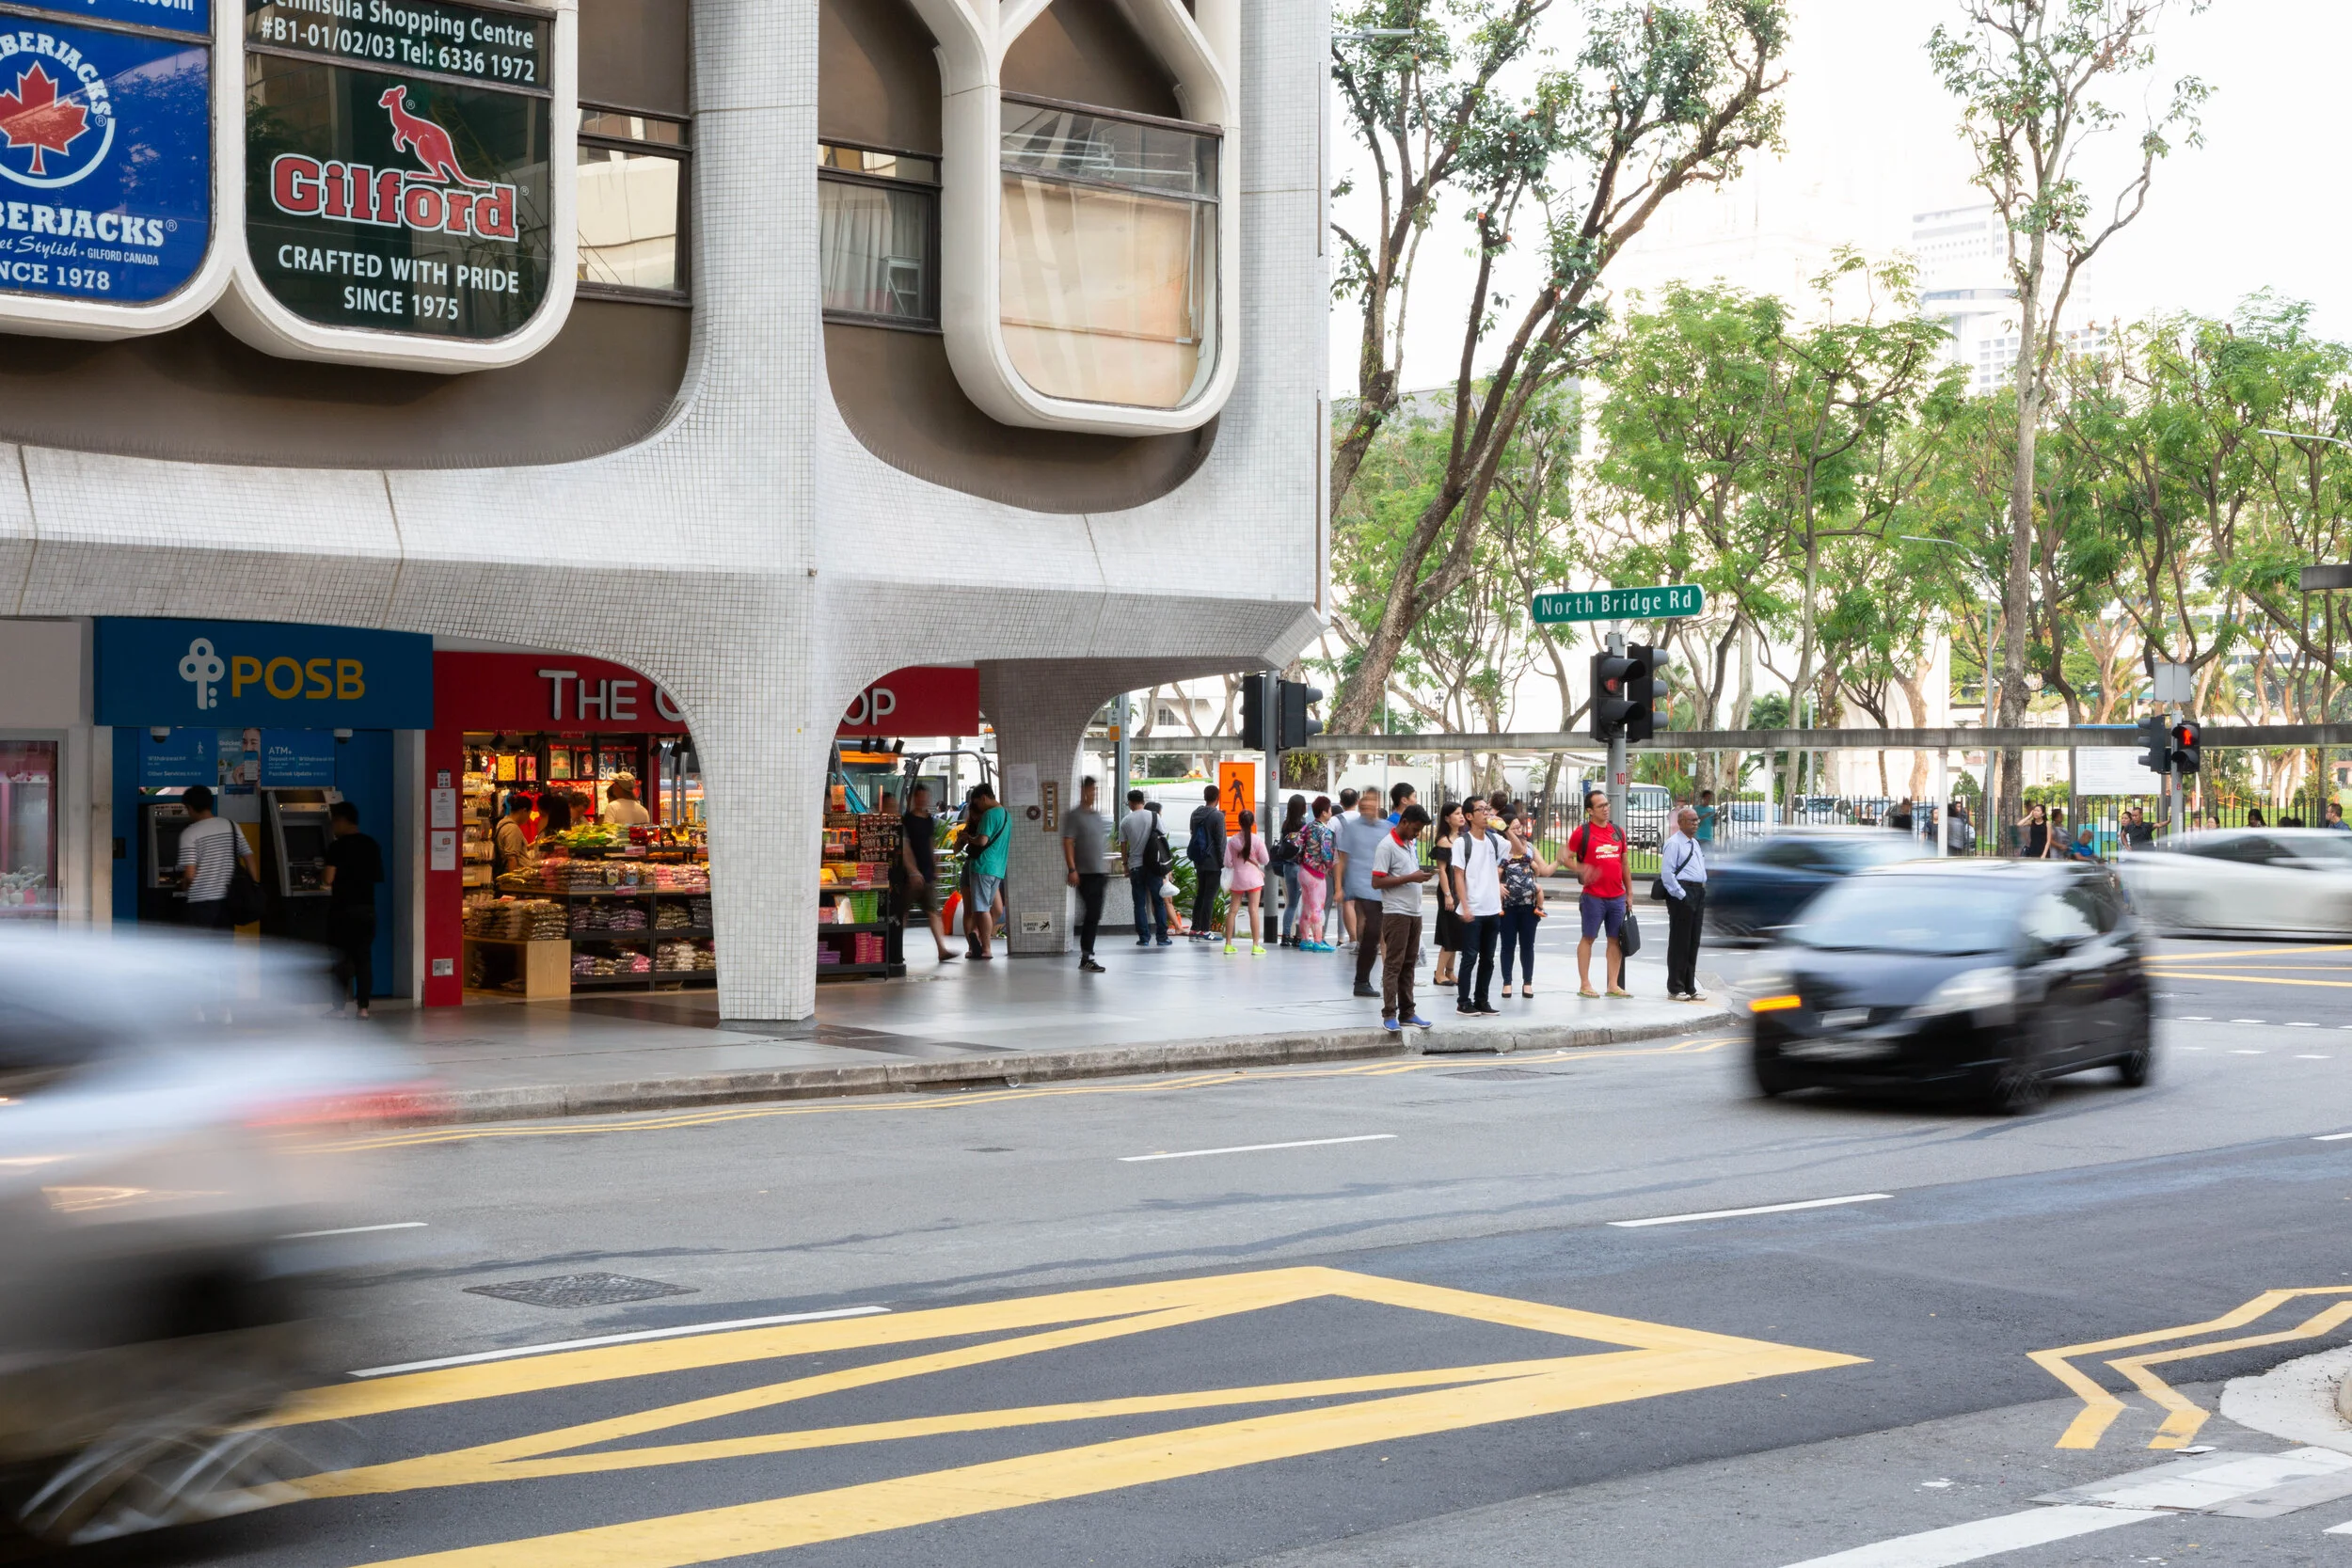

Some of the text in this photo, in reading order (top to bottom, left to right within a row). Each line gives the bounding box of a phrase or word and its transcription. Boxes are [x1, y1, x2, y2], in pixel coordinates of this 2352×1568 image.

[370, 0, 465, 43] Shopping
[470, 18, 534, 49] Centre
[262, 16, 534, 82] #B1-01/02/03 Tel: 6336 1972
[0, 31, 111, 115] BERJACKS
[271, 153, 518, 242] Gilford
[0, 200, 164, 247] ERJACKS
[14, 235, 77, 260] Stylish
[87, 247, 122, 262] GILFORD
[123, 251, 159, 265] CANADA
[278, 245, 519, 293] CRAFTED WITH PRIDE
[56, 266, 110, 290] 1978
[344, 286, 458, 320] SINCE 1975
[1541, 590, 1692, 615] North Bridge Rd
[231, 656, 365, 700] POSB
[538, 669, 637, 721] THE
[842, 688, 896, 726] OP
[1272, 771, 1277, 781] 9
[1616, 772, 1625, 784] 10
